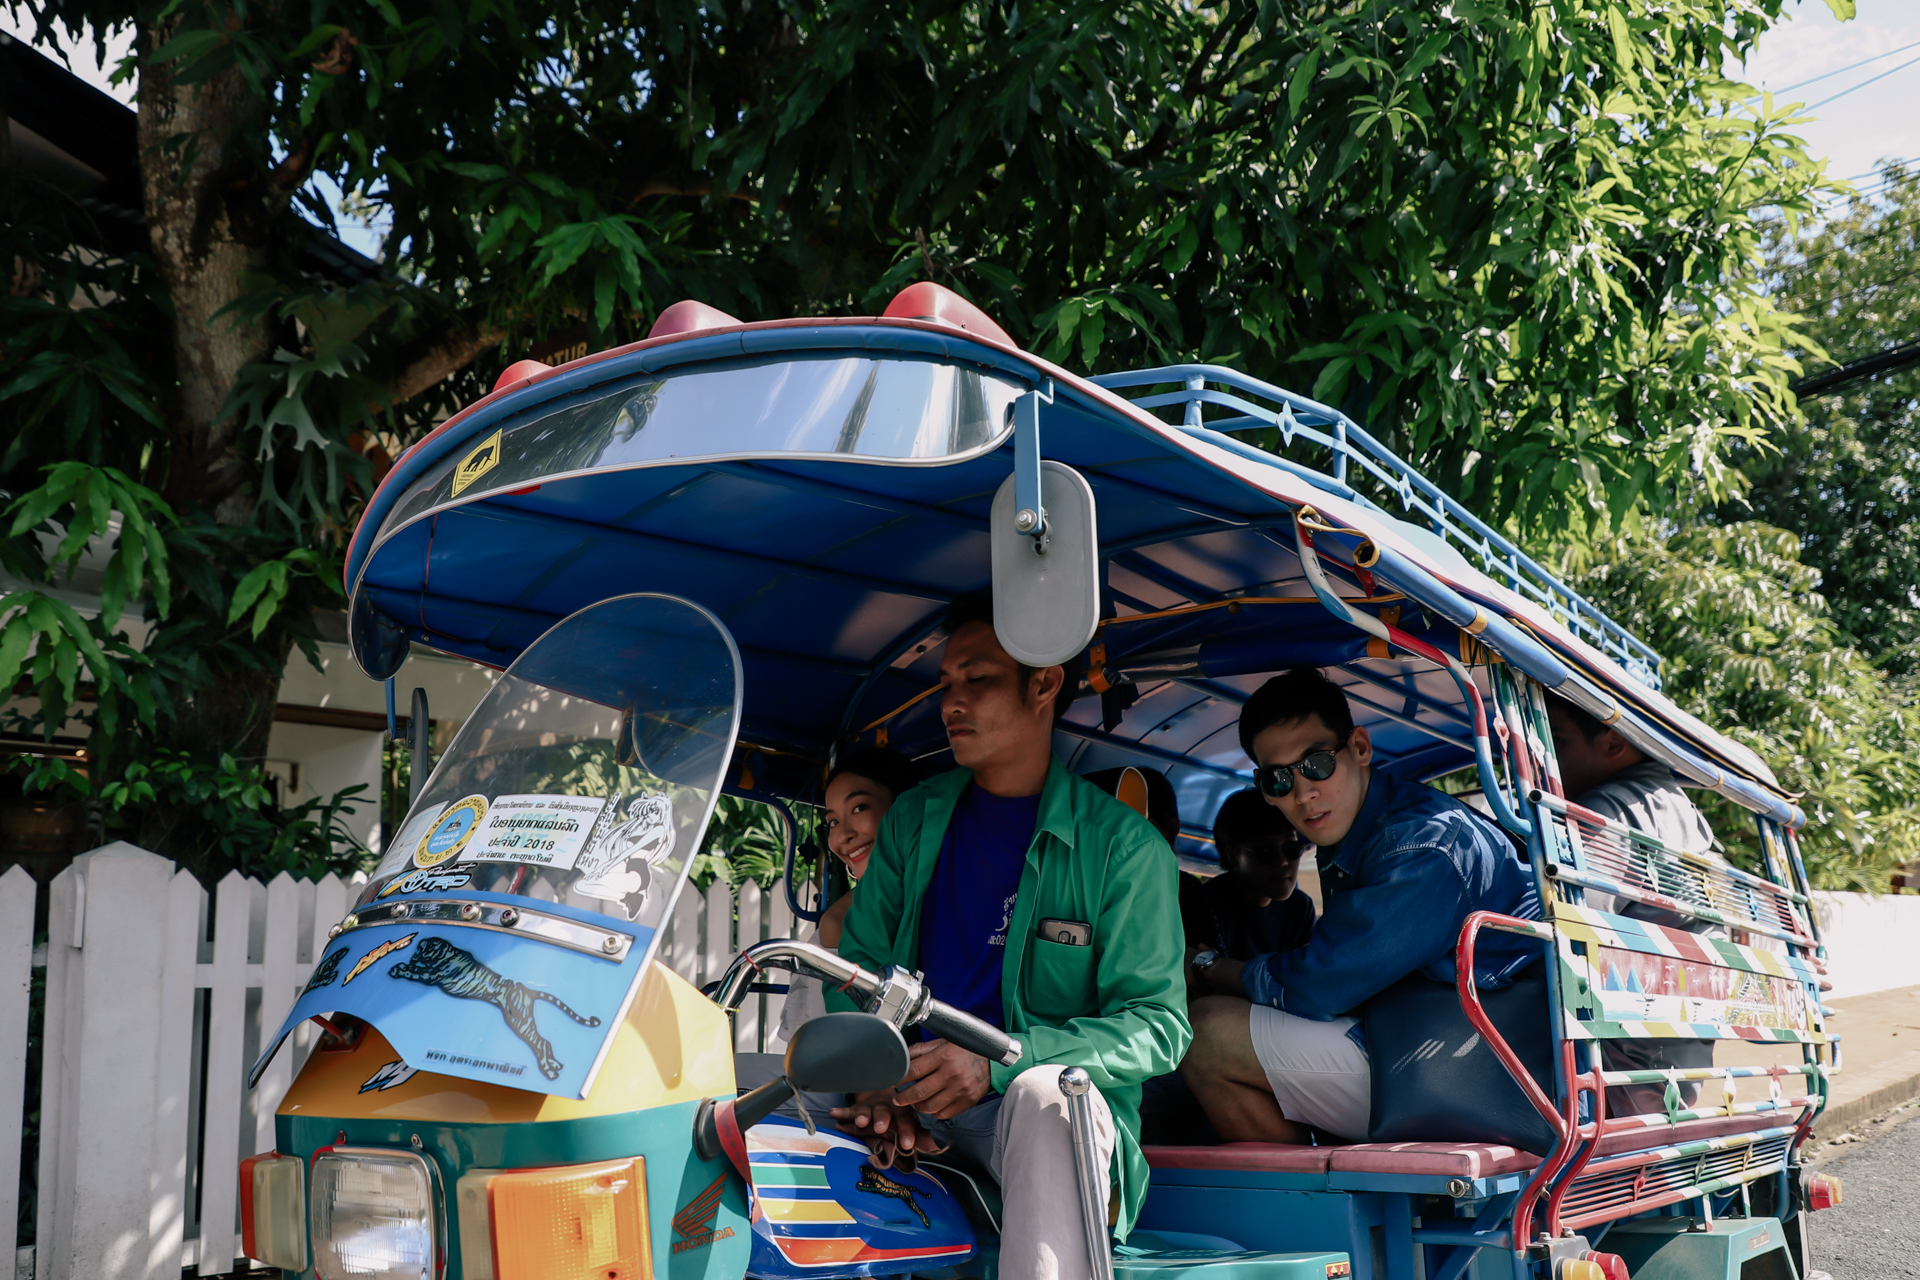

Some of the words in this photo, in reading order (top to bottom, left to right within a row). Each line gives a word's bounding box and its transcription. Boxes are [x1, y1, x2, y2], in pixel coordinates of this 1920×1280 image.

[540, 341, 588, 367] ATUR
[524, 838, 555, 851] 2018
[673, 1226, 735, 1254] HONDA
